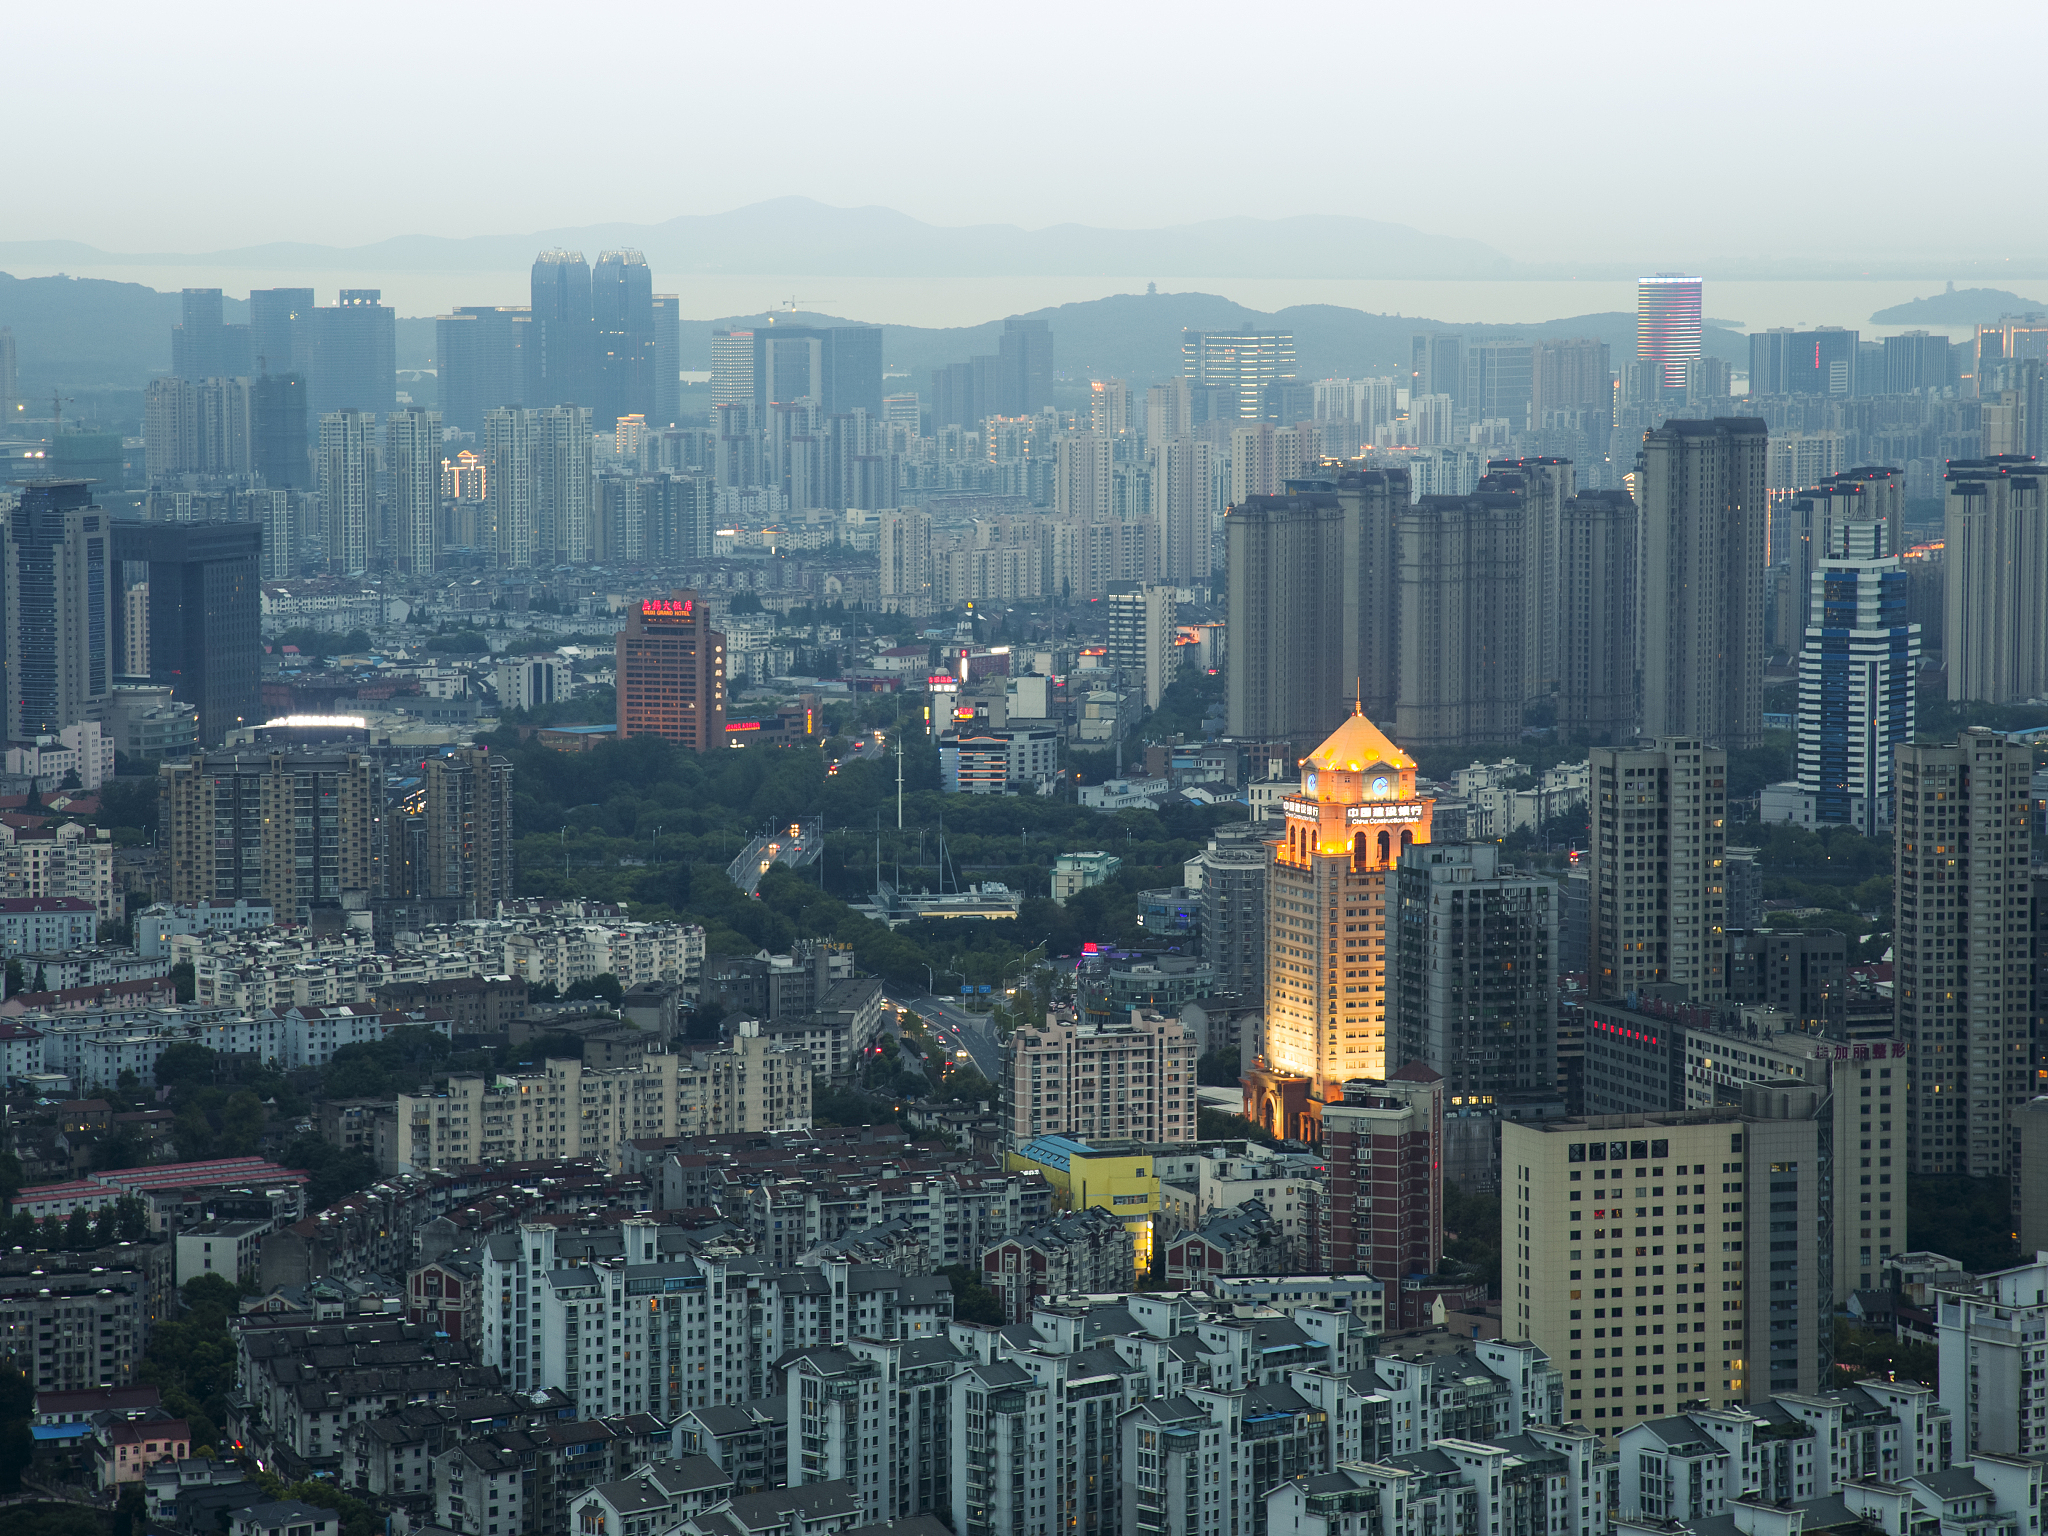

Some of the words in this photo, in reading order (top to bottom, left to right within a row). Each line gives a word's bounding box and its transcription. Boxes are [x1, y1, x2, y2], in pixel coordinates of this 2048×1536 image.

[1283, 801, 1319, 817] 中国建设银行
[1347, 805, 1423, 818] 中国建设银行
